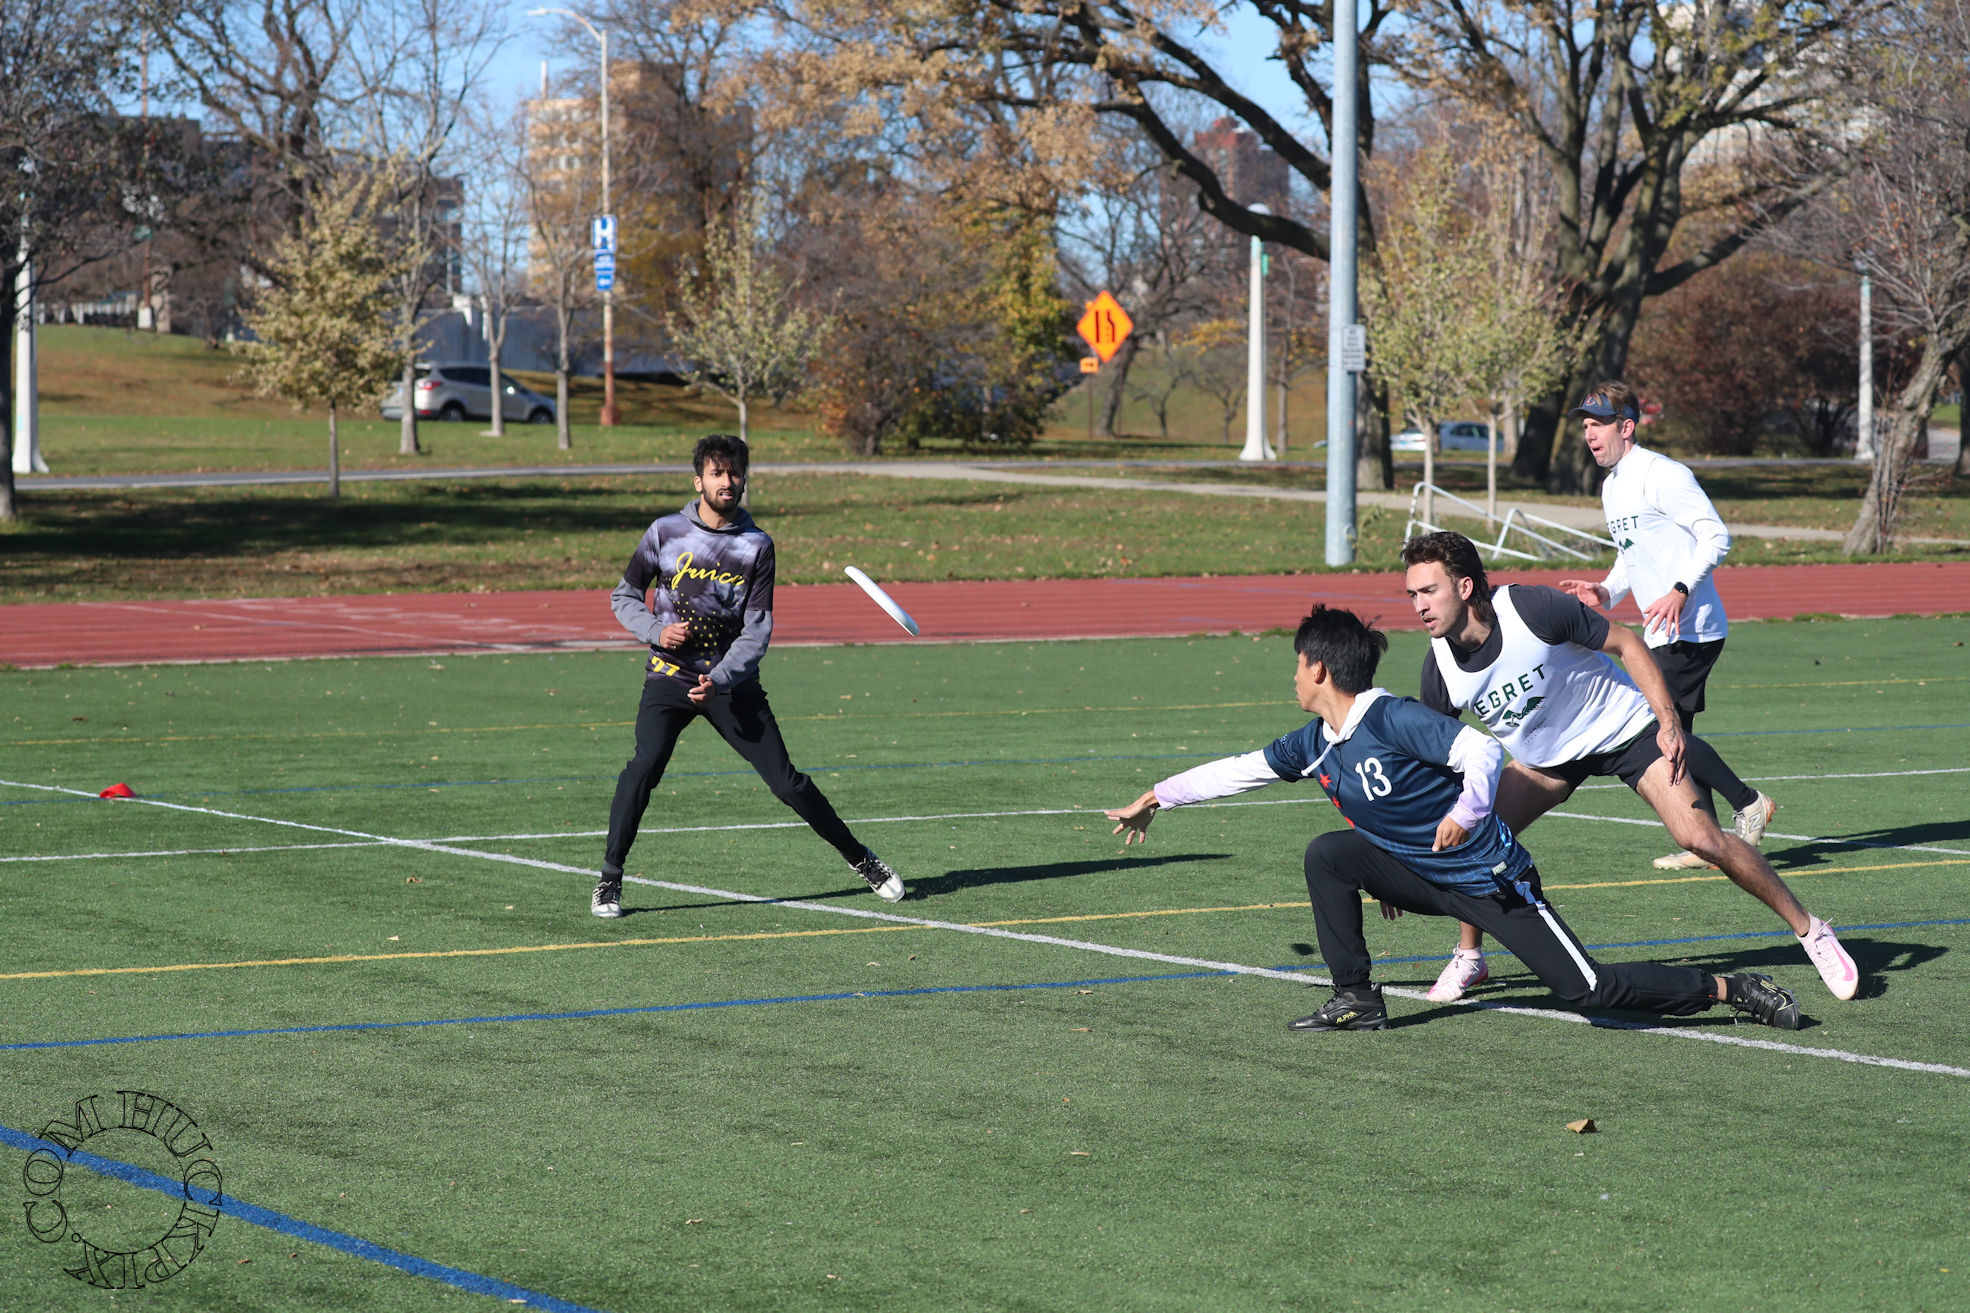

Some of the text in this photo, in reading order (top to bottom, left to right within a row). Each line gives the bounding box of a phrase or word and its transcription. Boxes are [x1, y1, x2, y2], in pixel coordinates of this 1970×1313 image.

[594, 217, 614, 249] H
[1606, 515, 1639, 534] GRET
[1473, 663, 1546, 716] EGRET
[1354, 757, 1393, 801] 13
[1336, 1011, 1359, 1024] ALPHA
